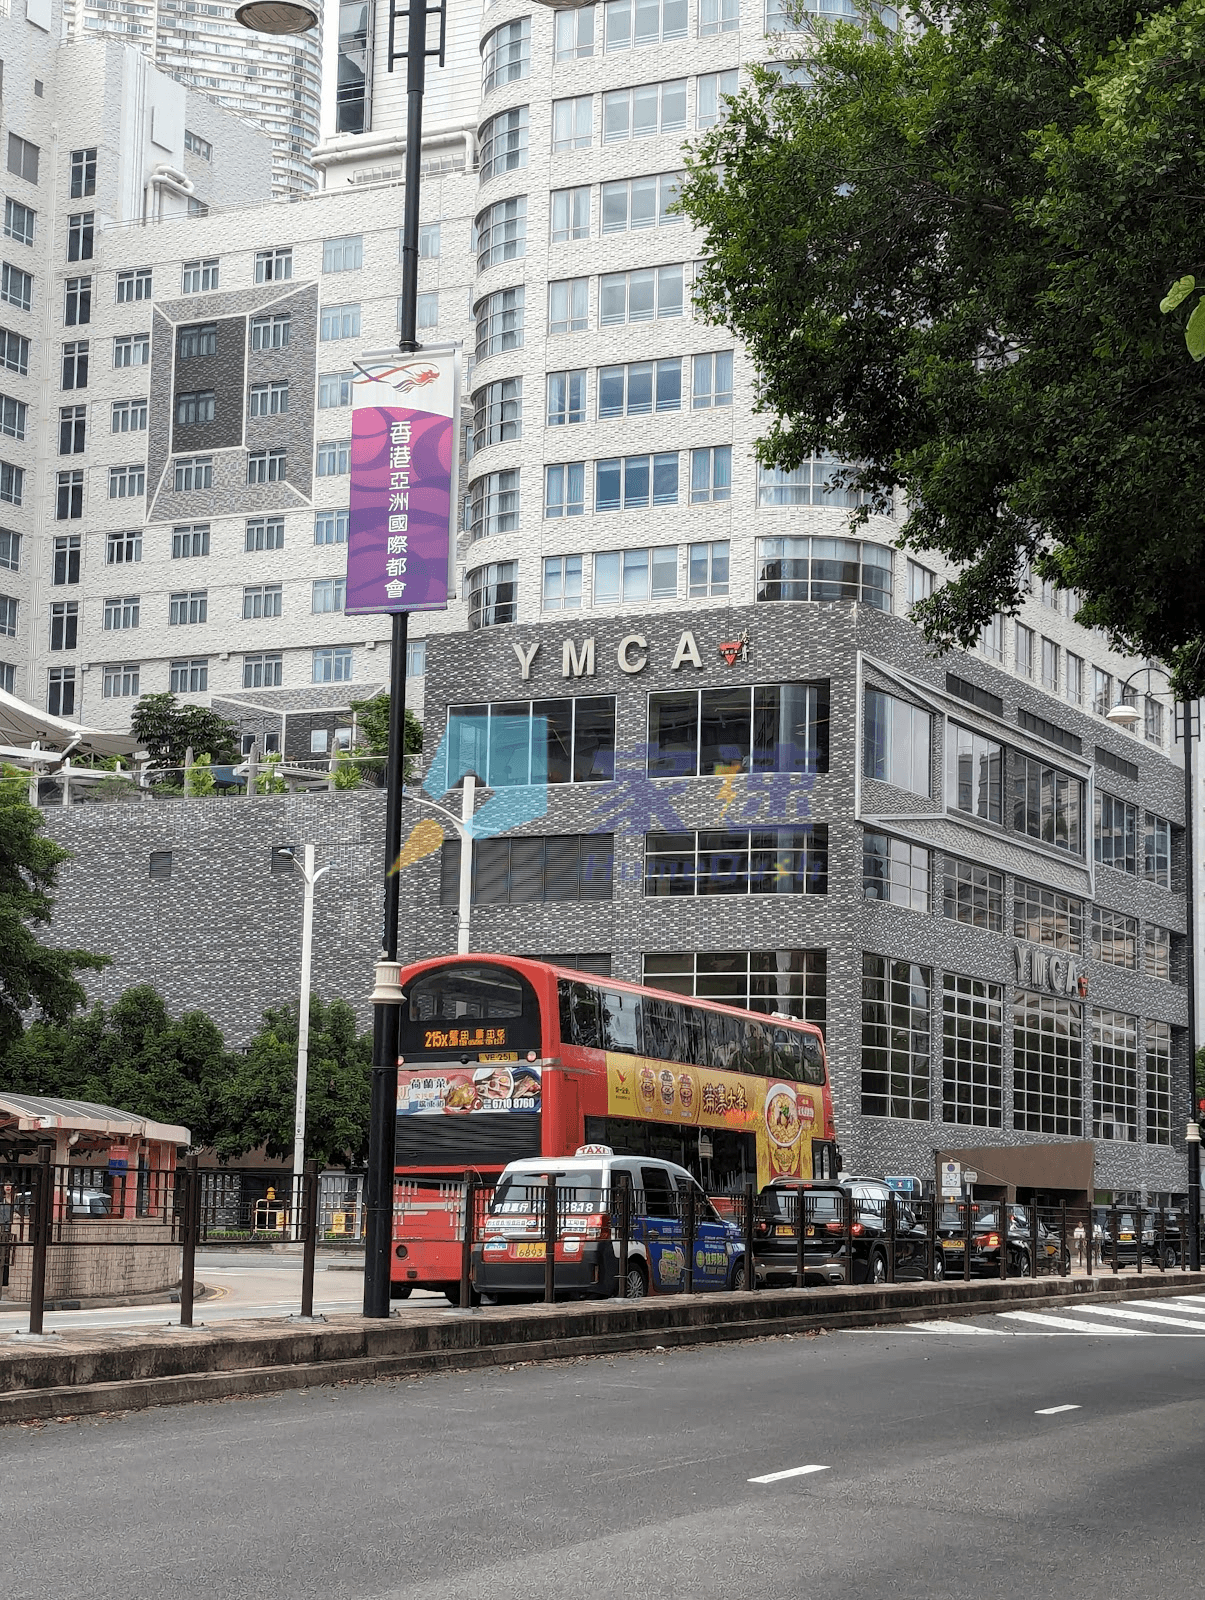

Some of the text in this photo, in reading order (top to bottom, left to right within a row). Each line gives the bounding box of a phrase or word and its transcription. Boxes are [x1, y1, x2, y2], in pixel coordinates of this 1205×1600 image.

[384, 421, 412, 599] 香港亞洲國際都會
[512, 631, 703, 681] YMCA
[1014, 944, 1079, 994] YMCA
[580, 1145, 606, 1154] TAXI
[519, 1249, 543, 1257] 6893
